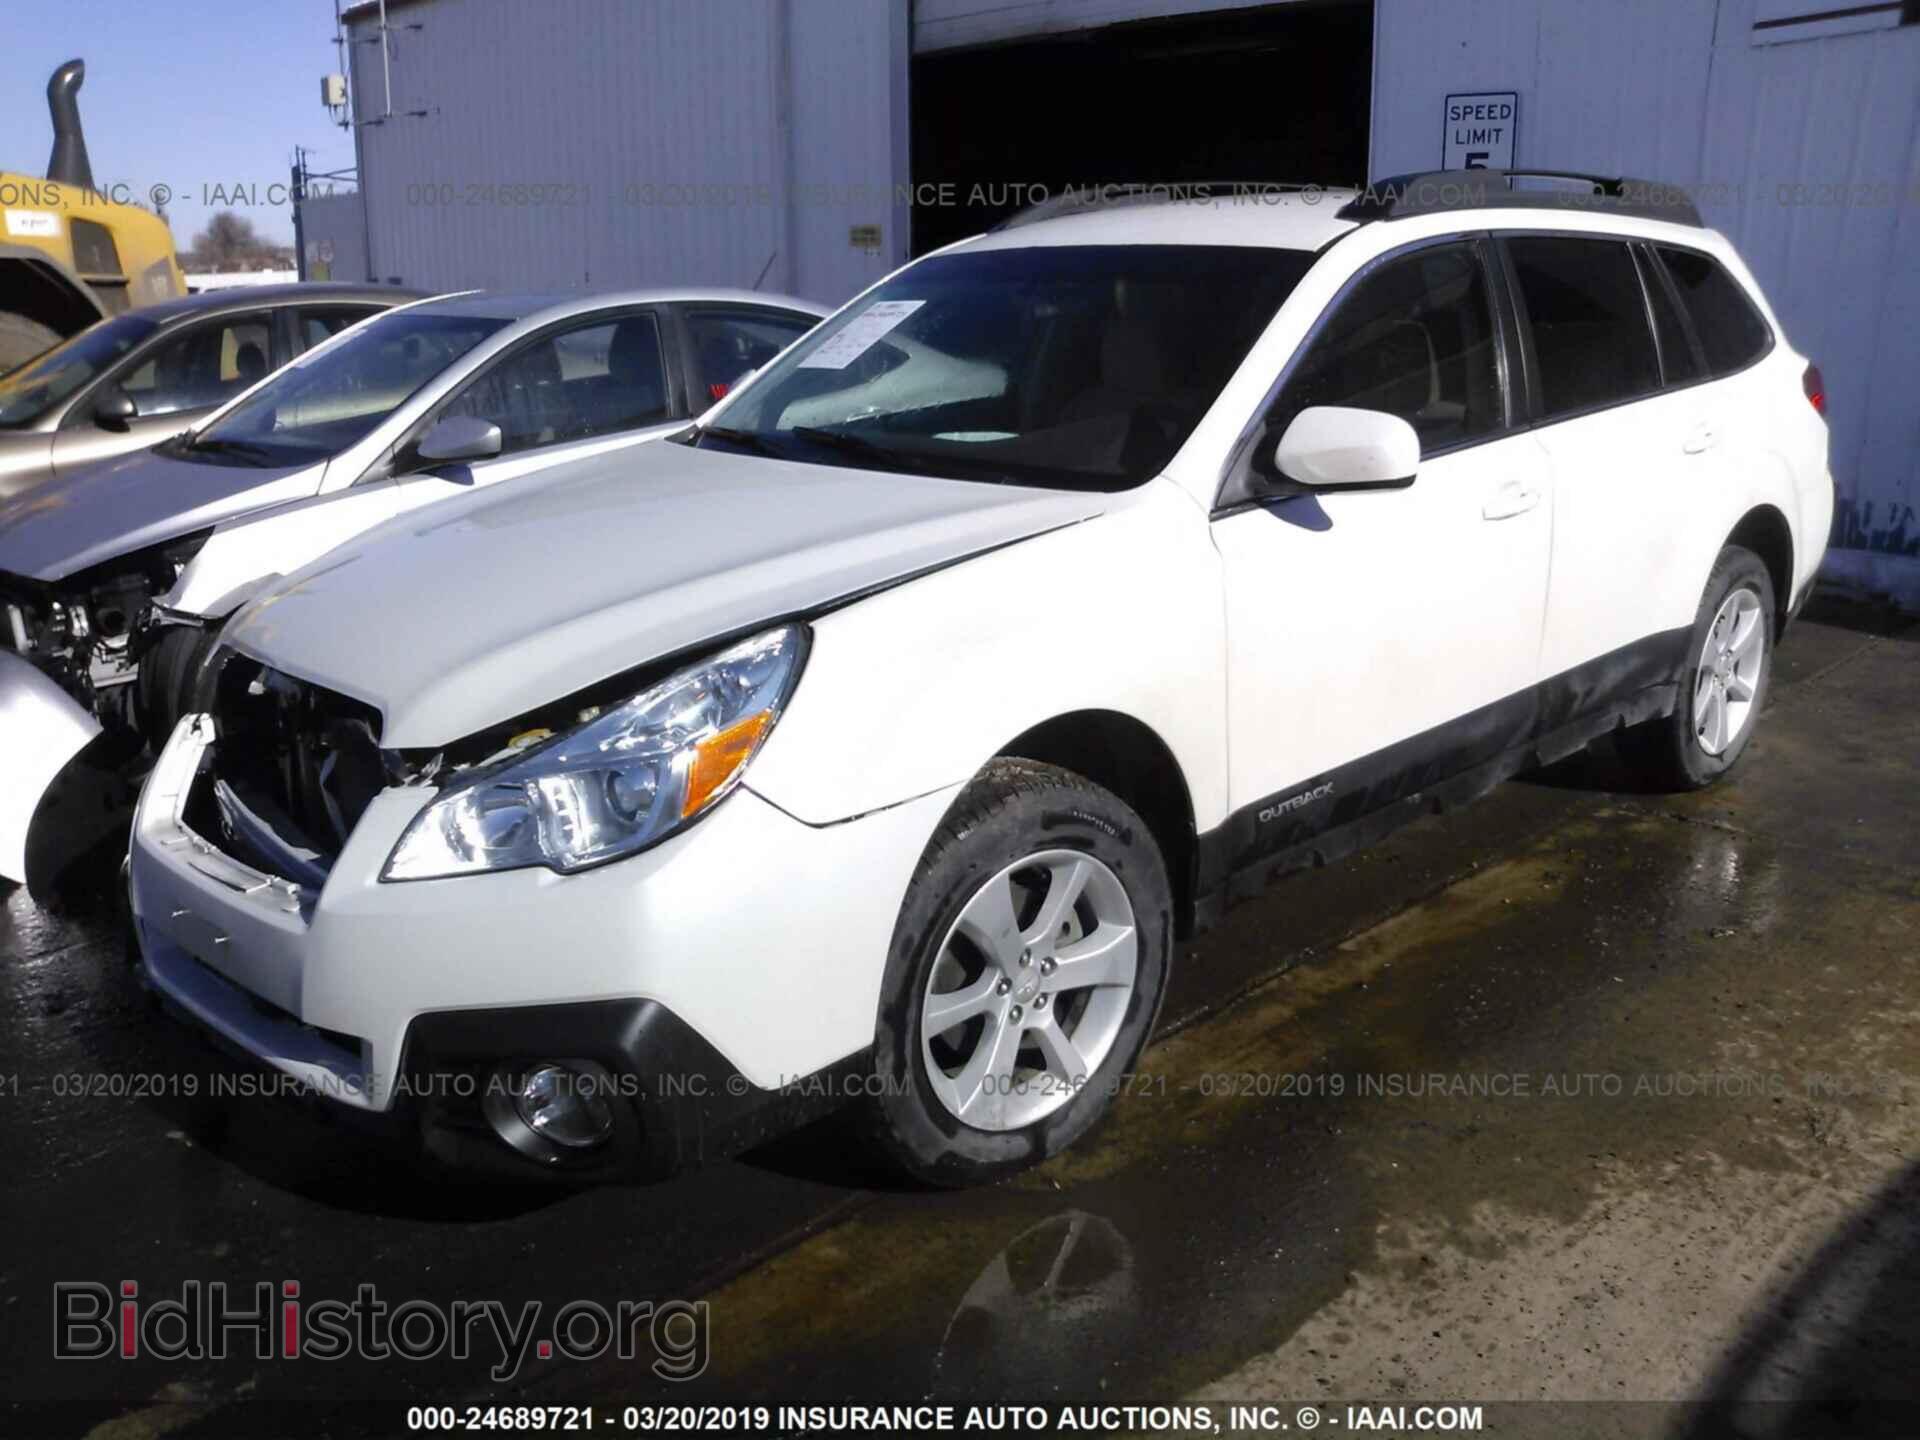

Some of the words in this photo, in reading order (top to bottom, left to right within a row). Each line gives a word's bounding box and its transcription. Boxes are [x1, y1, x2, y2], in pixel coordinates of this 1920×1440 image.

[1450, 104, 1512, 121] SPEED
[1455, 128, 1504, 145] LIMIT
[1259, 782, 1333, 822] OUTBACK
